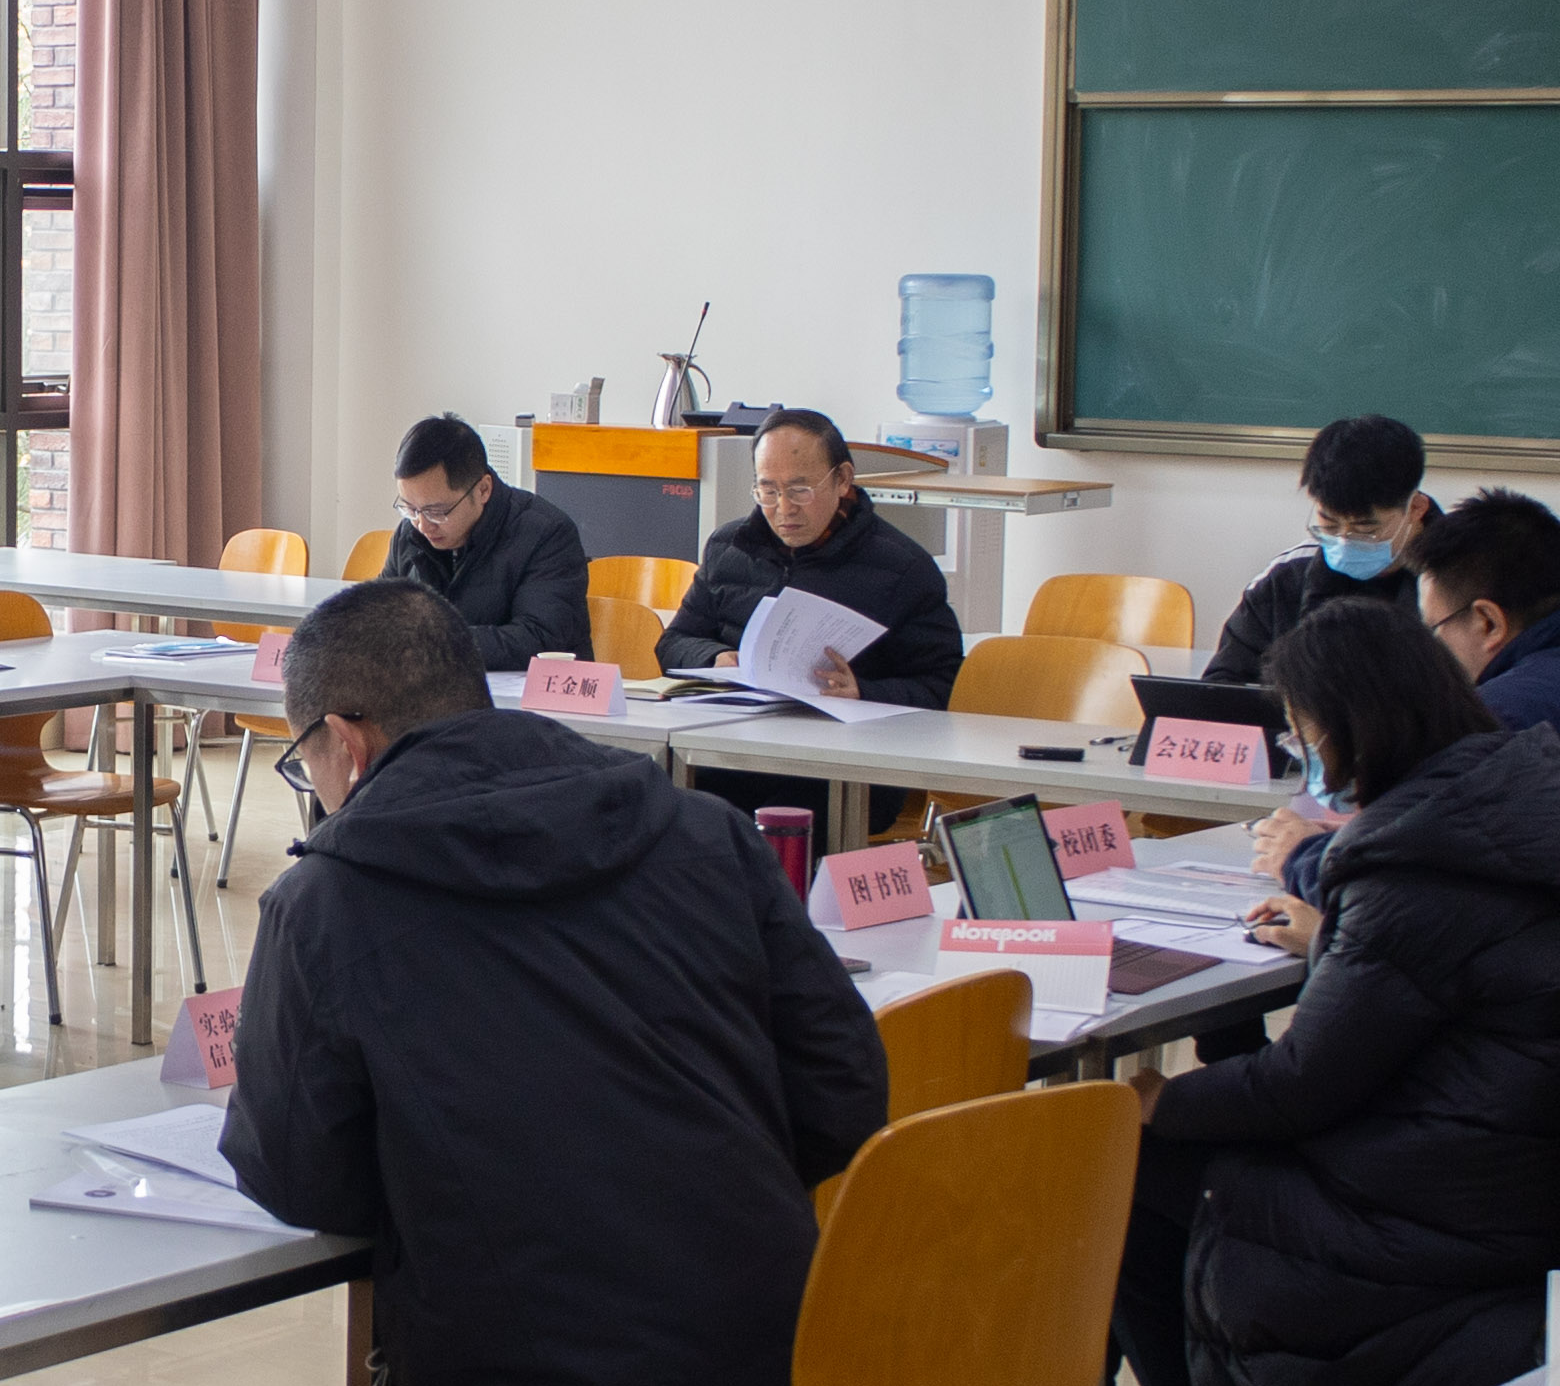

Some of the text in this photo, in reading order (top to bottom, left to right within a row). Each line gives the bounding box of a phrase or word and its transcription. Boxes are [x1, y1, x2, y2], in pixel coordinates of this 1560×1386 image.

[541, 674, 599, 700] 王金顺
[1155, 735, 1250, 767] 会议秘书
[1061, 823, 1117, 857] 校团委
[848, 866, 913, 905] 图书馆
[199, 1005, 241, 1037] 实验
